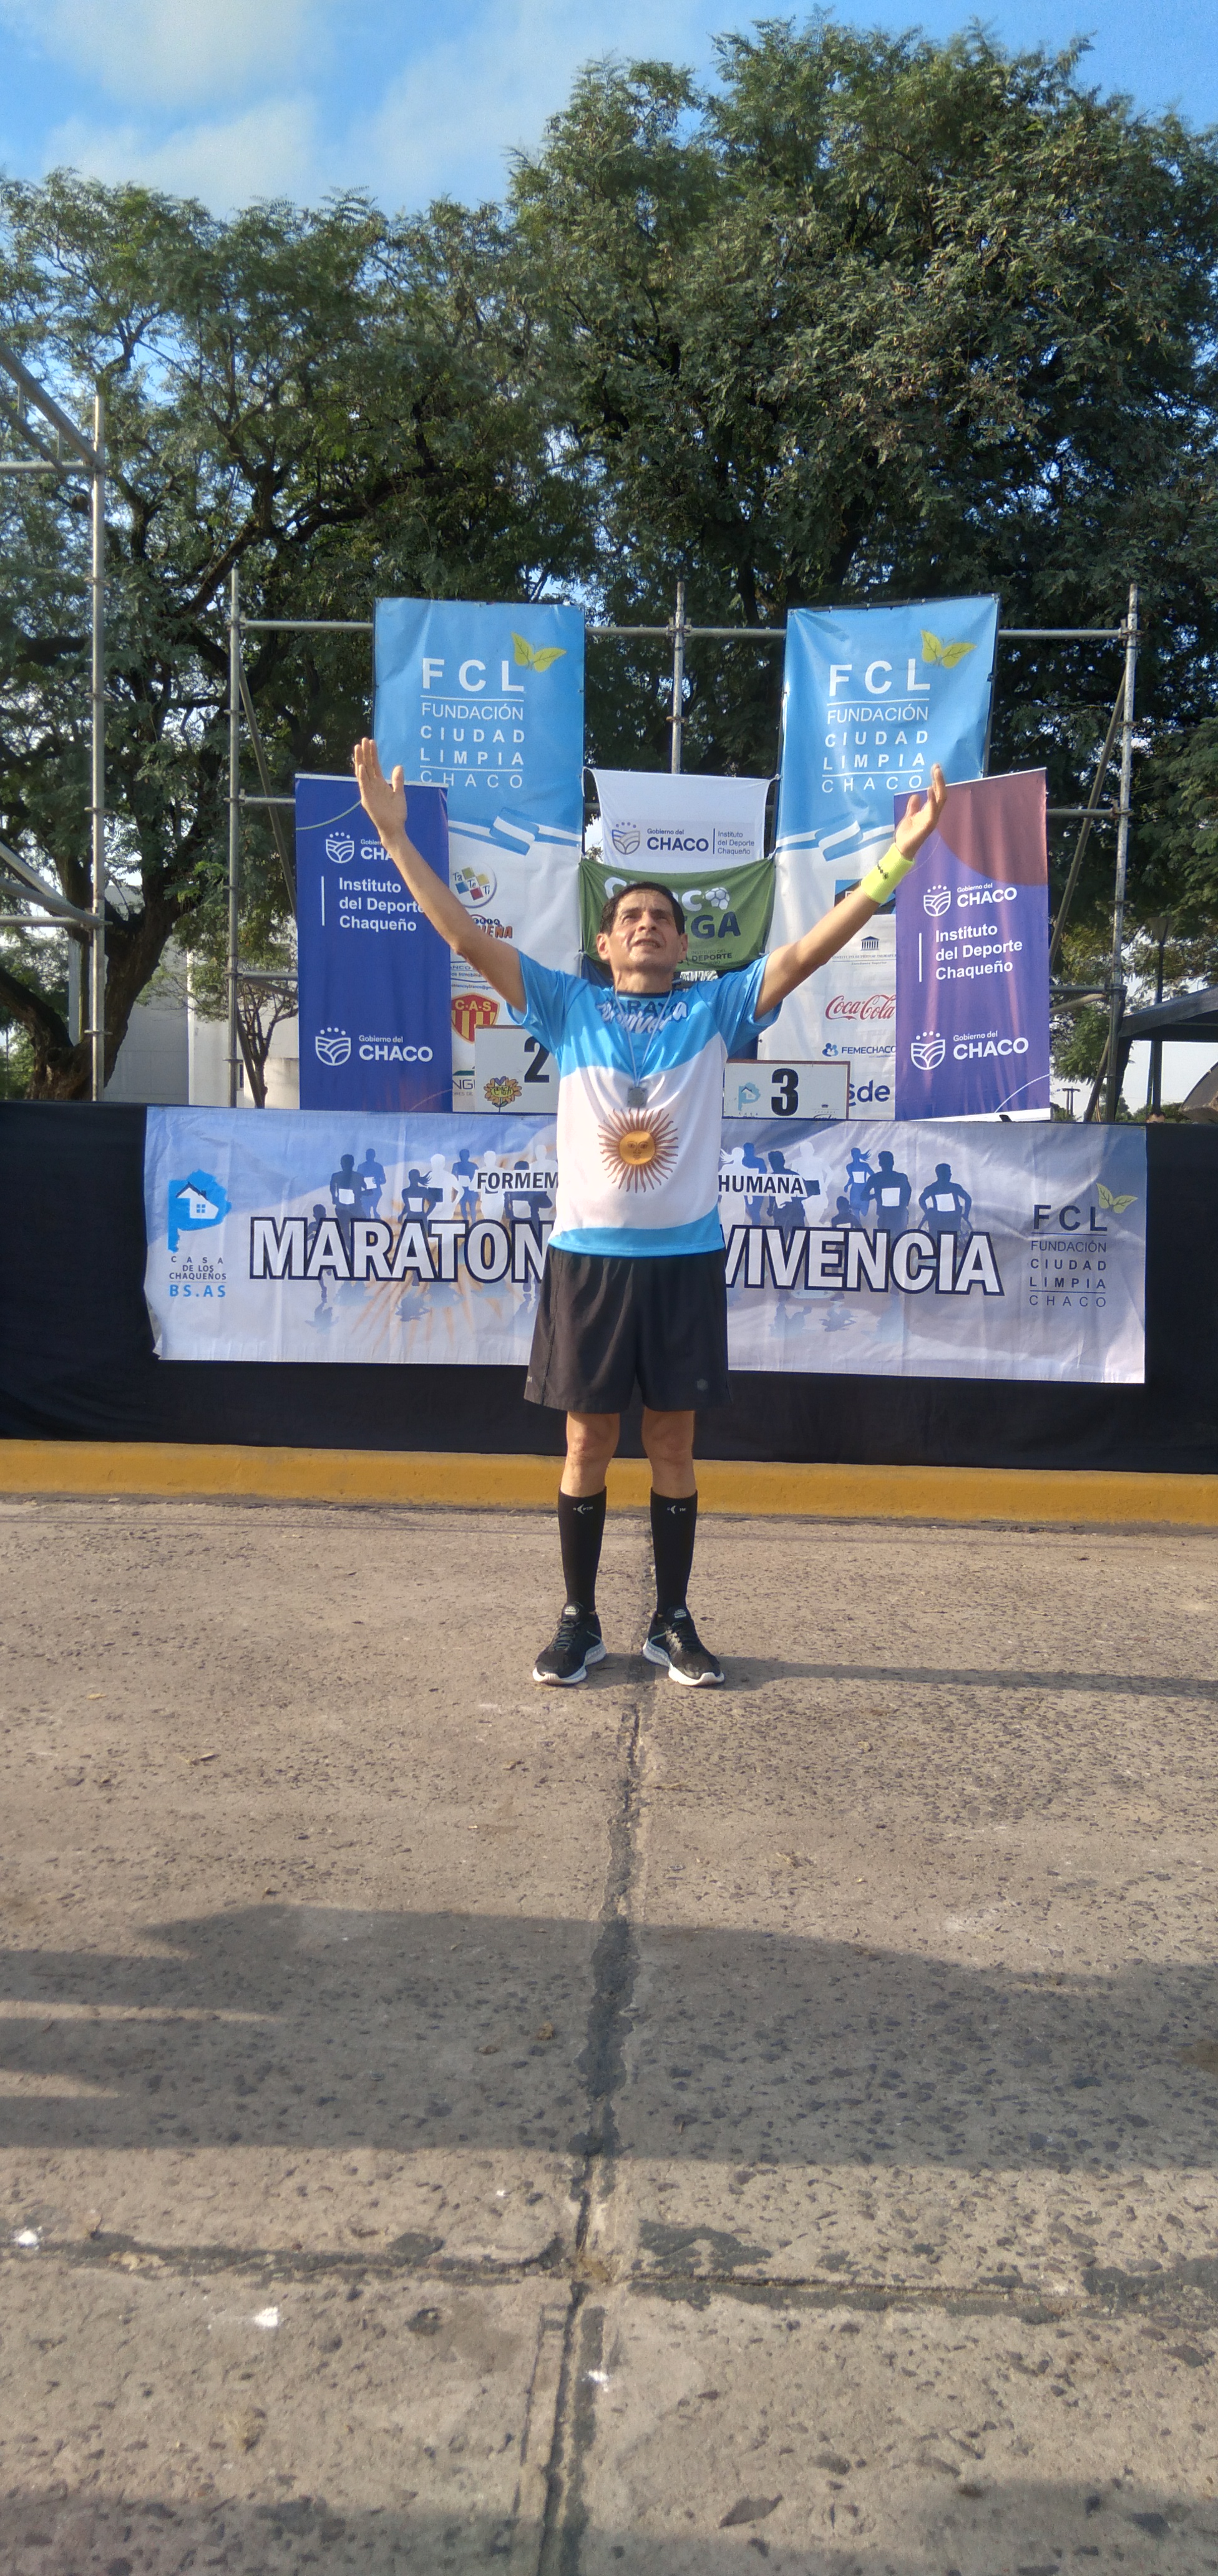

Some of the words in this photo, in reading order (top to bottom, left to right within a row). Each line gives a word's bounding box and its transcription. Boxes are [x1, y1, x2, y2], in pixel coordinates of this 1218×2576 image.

[421, 702, 524, 721] FUNDACIÓN
[827, 704, 928, 724] FUNDACIÓN
[421, 725, 525, 743] CIUDAD
[825, 730, 928, 748] CIUDAD
[421, 748, 524, 766] LIMPIA
[823, 753, 925, 771] LIMPIA
[421, 770, 523, 789] CHACO
[822, 775, 922, 793] CHACO
[647, 836, 709, 852] CHACO
[718, 847, 751, 856] Chaqueño
[729, 839, 754, 847] Deporte
[360, 847, 394, 861] CHA
[339, 877, 401, 893] Instituto
[339, 897, 362, 910] del
[367, 898, 424, 914] Deporte
[957, 887, 1017, 907] CHACO
[339, 915, 417, 932] Chaqueño
[936, 924, 998, 942] Instituto
[691, 953, 732, 961] DEPORTE
[936, 947, 958, 961] del
[963, 940, 1023, 958] Deporte
[936, 961, 1013, 980] Chaqueño
[359, 1035, 389, 1043] Gobierno
[953, 1033, 985, 1042] Gobierno
[987, 1030, 998, 1038] del
[359, 1045, 433, 1062] CHACO
[842, 1046, 896, 1054] FEMECHACO
[953, 1037, 1029, 1060] CHACO
[524, 1036, 550, 1083] 2
[771, 1068, 799, 1116] 3
[477, 1172, 558, 1189] FORMEM
[719, 1175, 804, 1194] HUMANA
[1031, 1240, 1106, 1253] FUNDACIÓN
[170, 1256, 223, 1264] CASA
[250, 1216, 553, 1284] MARATON
[725, 1224, 1005, 1296] VIVENCIA
[1030, 1259, 1106, 1271] CIUDAD
[169, 1271, 227, 1281] CHAQUEÑOS
[1030, 1277, 1106, 1289] LIMPIA
[1030, 1295, 1106, 1307] CHACO
